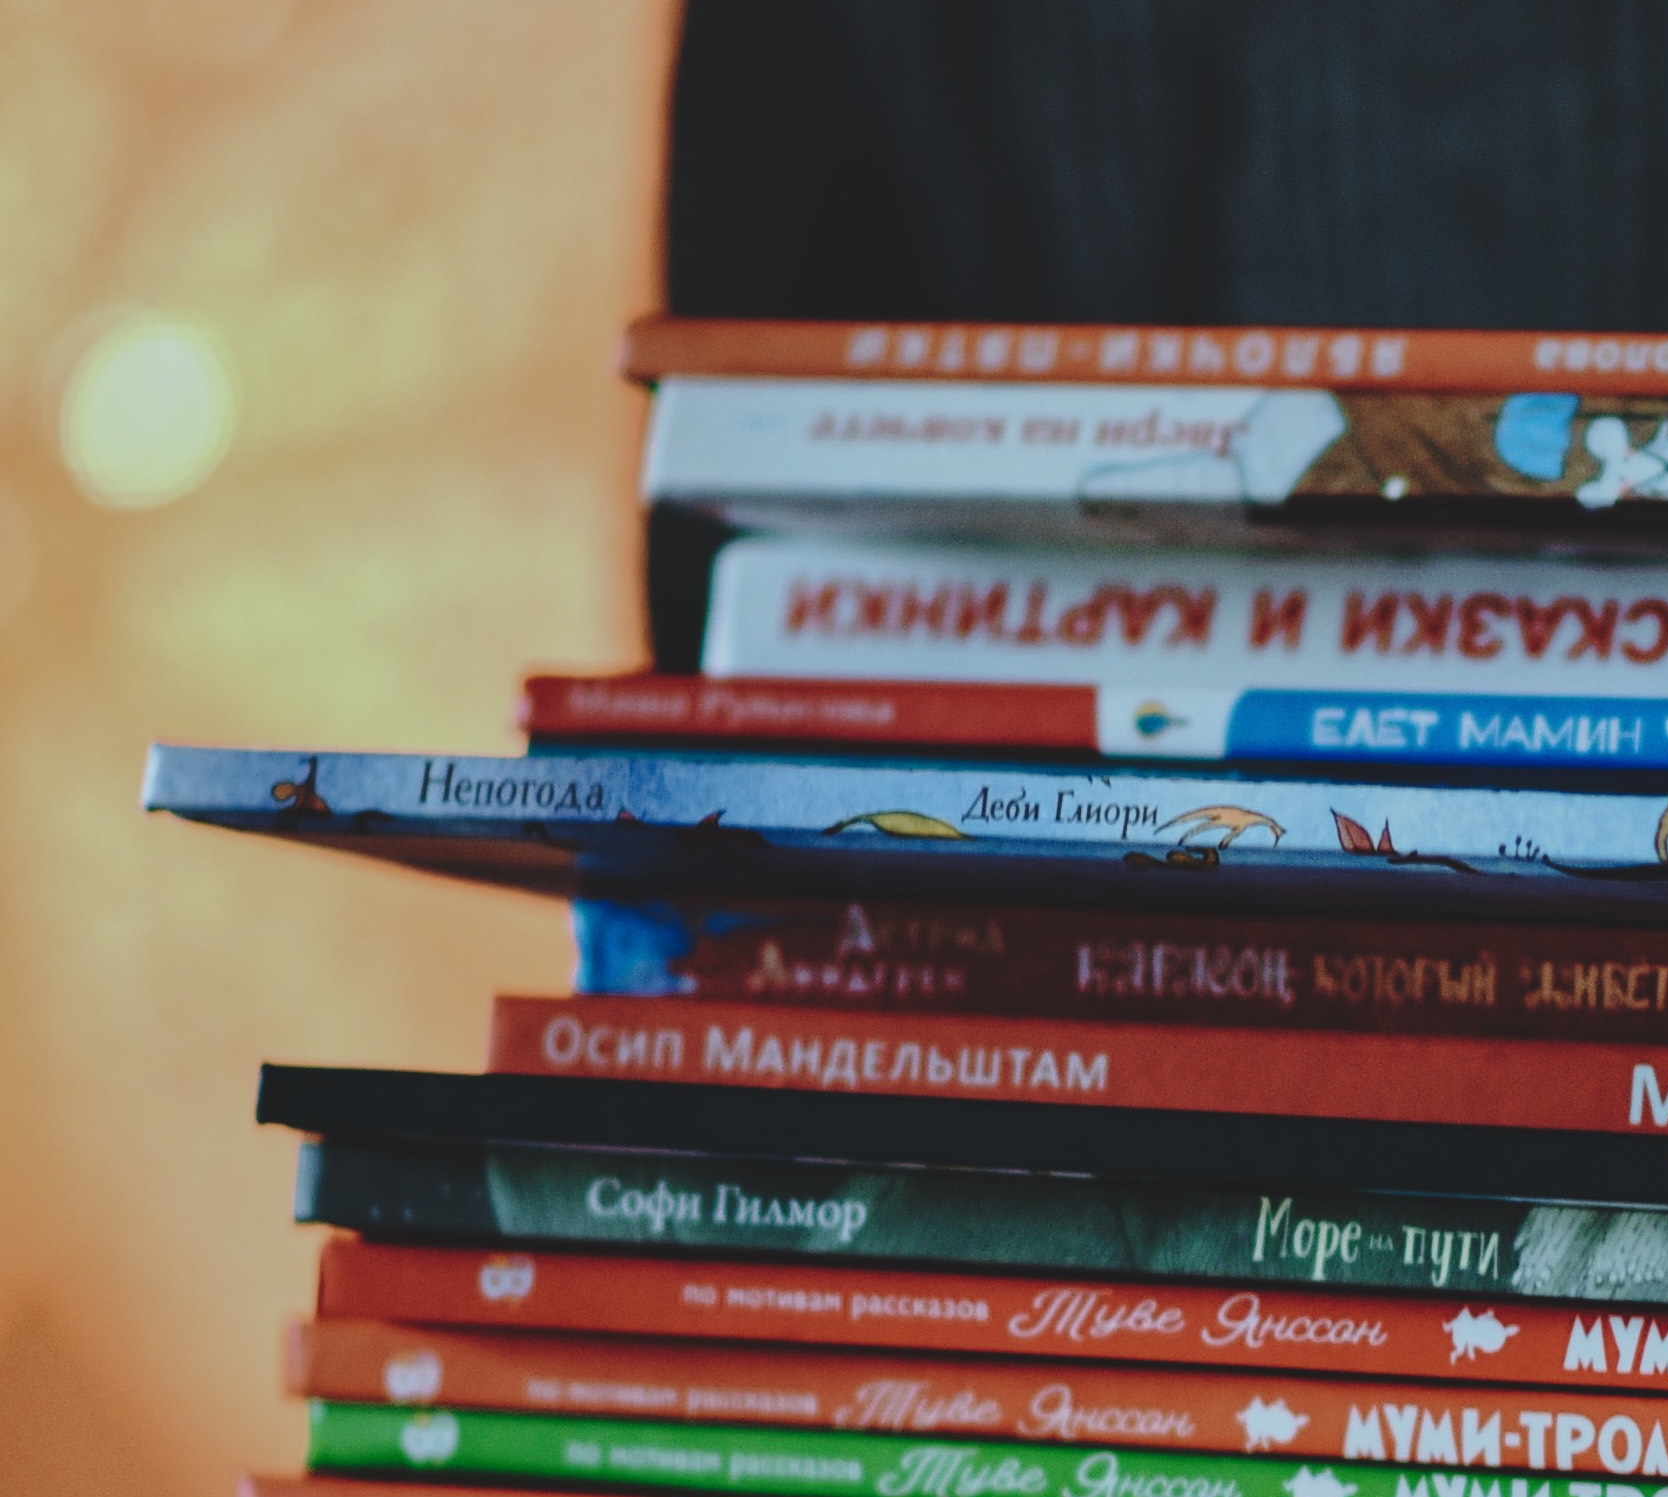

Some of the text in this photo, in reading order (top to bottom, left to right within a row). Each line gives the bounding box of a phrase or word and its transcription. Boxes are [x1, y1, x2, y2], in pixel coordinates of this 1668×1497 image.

[785, 582, 1218, 651] КАРТИНКИ
[1250, 590, 1307, 650] И
[1458, 711, 1642, 754] МАМИН
[418, 761, 603, 812] Непогода
[962, 785, 1160, 840] Деби Глиори
[587, 1178, 868, 1239] Софи Гилмор
[1252, 1196, 1362, 1281] Море
[1402, 1224, 1500, 1288] пути
[1007, 1289, 1186, 1342] Туве
[1201, 1292, 1388, 1349] Янссон
